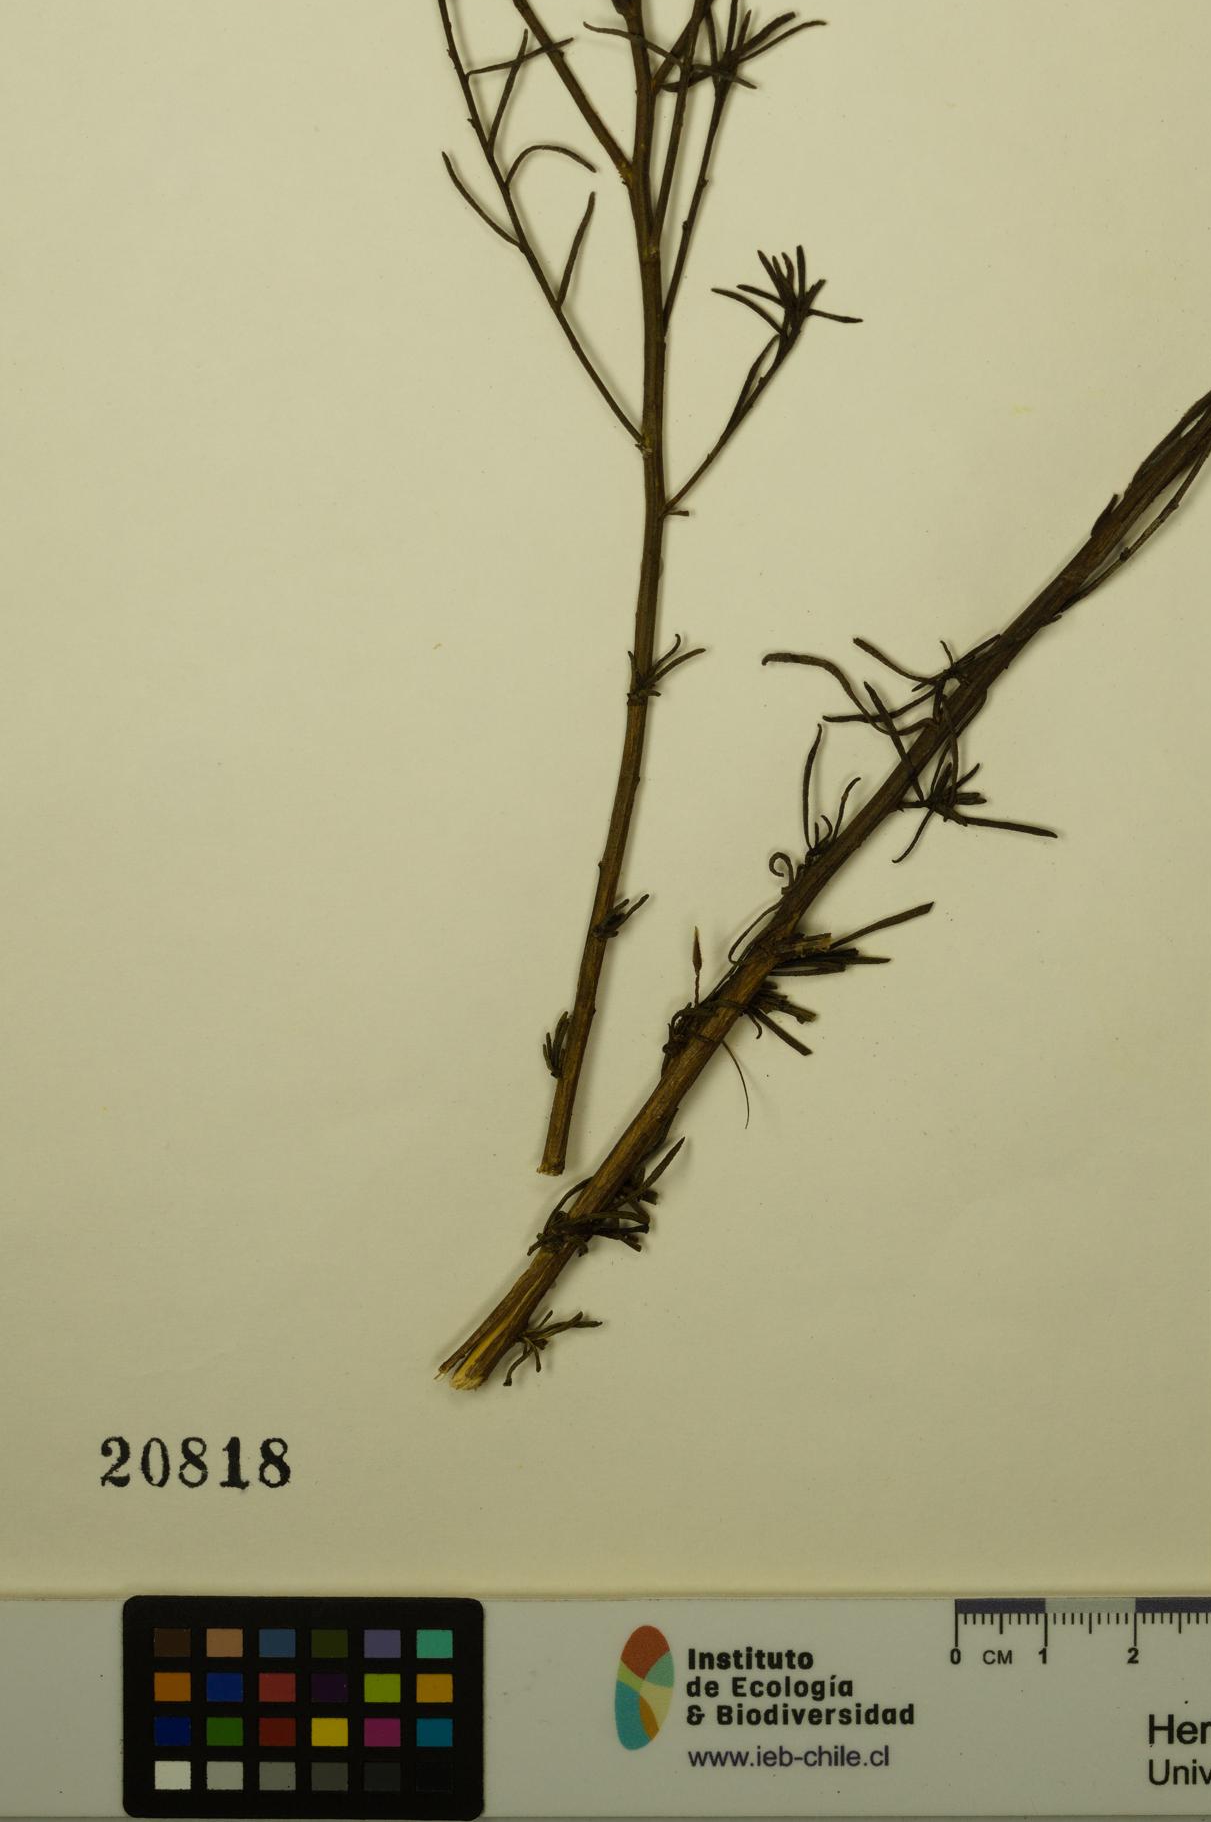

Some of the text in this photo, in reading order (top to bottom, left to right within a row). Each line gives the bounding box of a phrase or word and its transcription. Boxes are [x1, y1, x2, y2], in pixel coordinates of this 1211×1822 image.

[101, 1436, 291, 1490] 20818
[689, 1647, 813, 1670] Instituto
[950, 1648, 961, 1665] 0
[982, 1650, 1013, 1665] CM
[1038, 1648, 1048, 1664] 1
[1127, 1647, 1139, 1664] 2
[687, 1675, 853, 1701] de Ecología
[687, 1703, 914, 1725] & Biodiversidad
[688, 1745, 889, 1767] www.ieb-chile.cl
